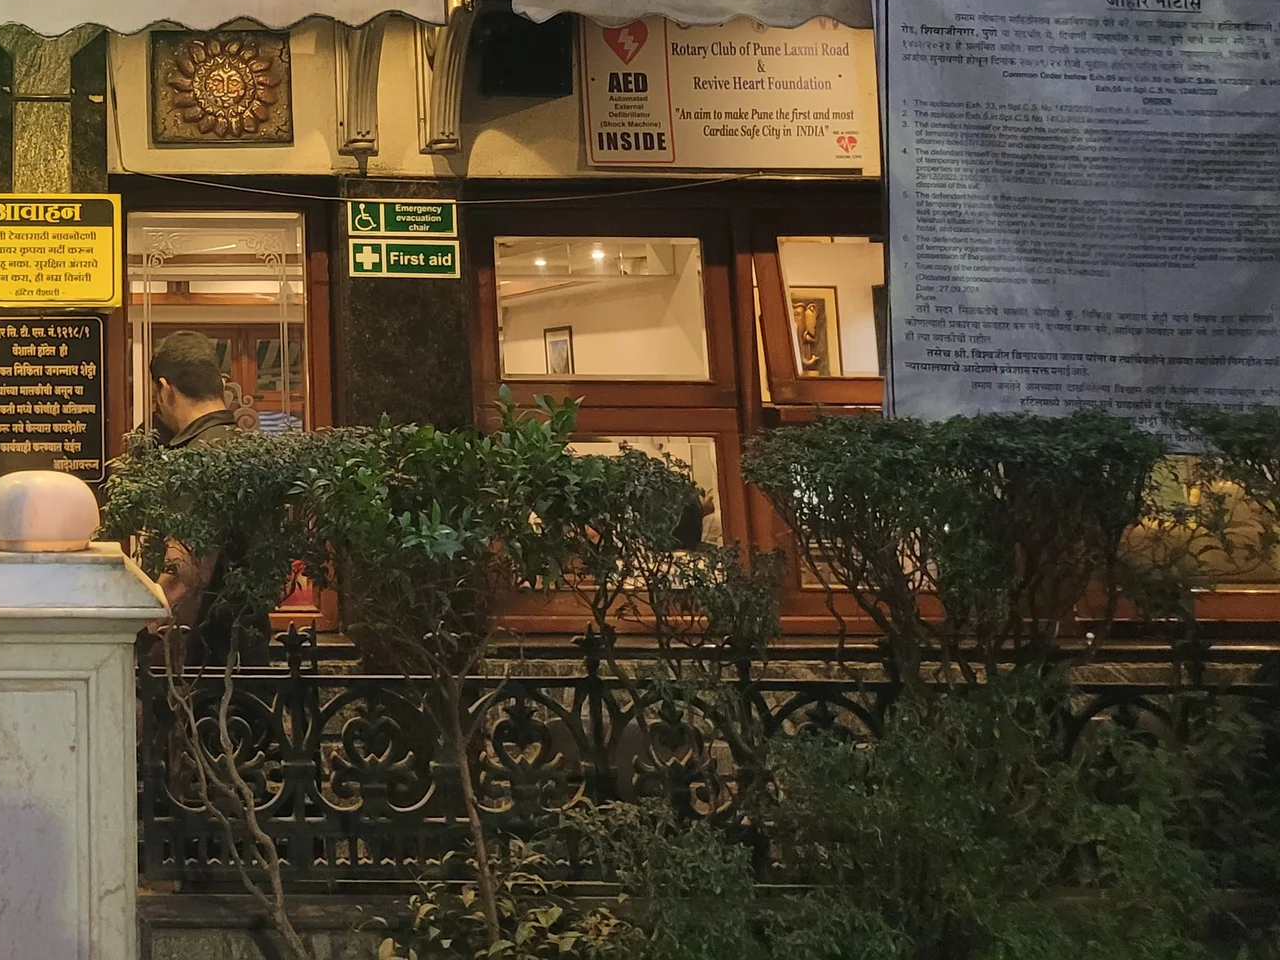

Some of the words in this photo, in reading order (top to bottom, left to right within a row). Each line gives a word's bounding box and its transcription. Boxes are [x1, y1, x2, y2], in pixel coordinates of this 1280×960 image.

[920, 24, 979, 38] शिवाजीनगर,
[671, 41, 709, 59] Rotary
[711, 41, 737, 57] Club
[739, 41, 751, 57] of
[753, 42, 781, 57] Pune
[784, 41, 819, 57] Laxmi
[821, 41, 850, 57] Road
[757, 59, 766, 73] &
[608, 72, 648, 93] AED
[693, 76, 730, 90] Revive
[733, 76, 766, 90] Heart
[768, 76, 832, 91] Foundation
[694, 108, 711, 121] aim
[713, 110, 722, 121] to
[724, 108, 749, 121] make
[751, 109, 774, 121] Pune
[775, 108, 789, 121] the
[791, 108, 813, 122] first
[815, 108, 830, 121] and
[832, 110, 855, 121] most
[703, 124, 739, 137] Cardiac
[741, 124, 760, 139] Safe
[762, 124, 781, 140] City
[783, 124, 792, 137] in
[796, 125, 830, 138] INDIA"
[597, 131, 668, 151] INSIDE
[395, 204, 442, 214] Emergency
[8, 230, 49, 240] टेबलसाठी
[19, 246, 46, 257] कृपया
[48, 245, 65, 254] गर्दी
[67, 246, 94, 254] करून
[34, 258, 66, 270] सुरक्षित
[69, 258, 98, 268] अंतराचे
[389, 252, 425, 266] First
[428, 253, 452, 266] aid
[11, 273, 32, 283] करा,
[34, 272, 44, 282] ही
[46, 273, 61, 282] नम्र
[64, 272, 92, 282] विनंती
[35, 288, 60, 296] वैशाली
[12, 343, 36, 357] वैशाली
[37, 343, 56, 358] हॉटेल
[59, 343, 68, 358] ही
[14, 362, 43, 376] निकिता
[44, 365, 79, 377] जगन्नाथ
[19, 383, 52, 396] मालकीची
[54, 385, 73, 399] असून
[74, 386, 84, 396] या
[17, 401, 32, 415] मध्ये
[33, 401, 60, 416] कोणीही
[12, 420, 24, 433] नये
[25, 420, 51, 433] केल्यास
[52, 420, 87, 434] कायदेशीर
[0, 440, 31, 453] कार्यवाही
[32, 441, 62, 453] करण्यात
[63, 439, 81, 453] येईल
[53, 456, 99, 471] आदेशावरून
